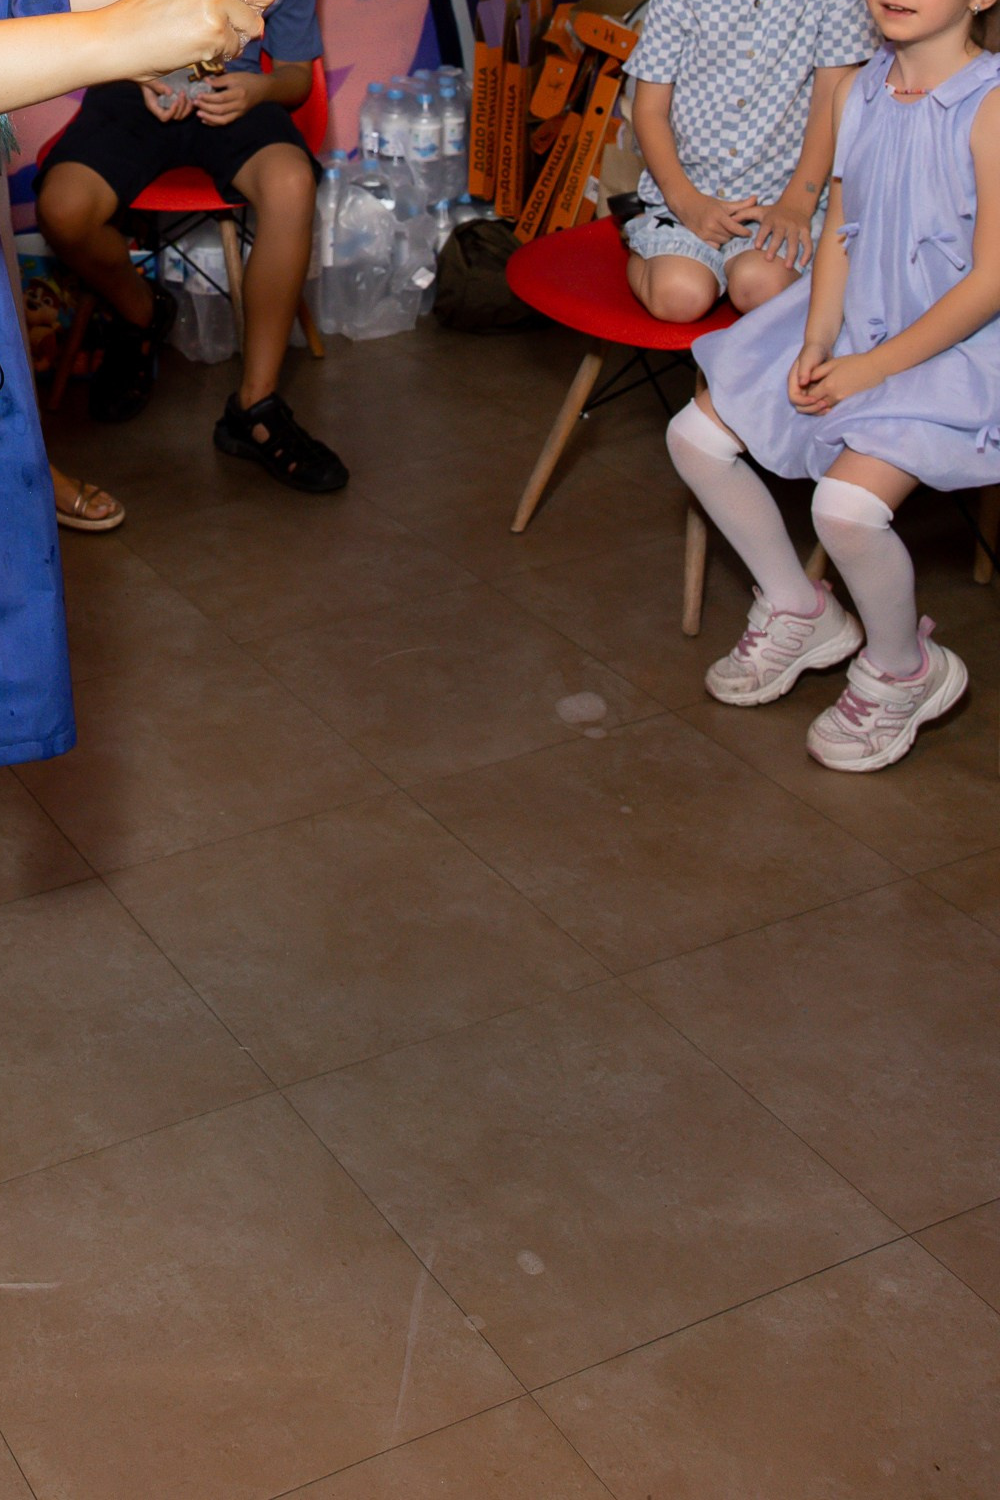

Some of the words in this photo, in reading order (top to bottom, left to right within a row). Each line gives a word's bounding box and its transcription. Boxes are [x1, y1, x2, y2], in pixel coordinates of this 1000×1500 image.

[477, 67, 488, 123] ПИЦЦА
[504, 84, 516, 141] ПИЦЦА
[474, 126, 486, 172] ДОДО
[500, 144, 512, 191] ДОДО
[561, 176, 578, 212] ДОДО
[573, 130, 594, 173] ПИЦЦА
[521, 190, 545, 234] ДОДО
[541, 134, 571, 188] ПИЦЦА
